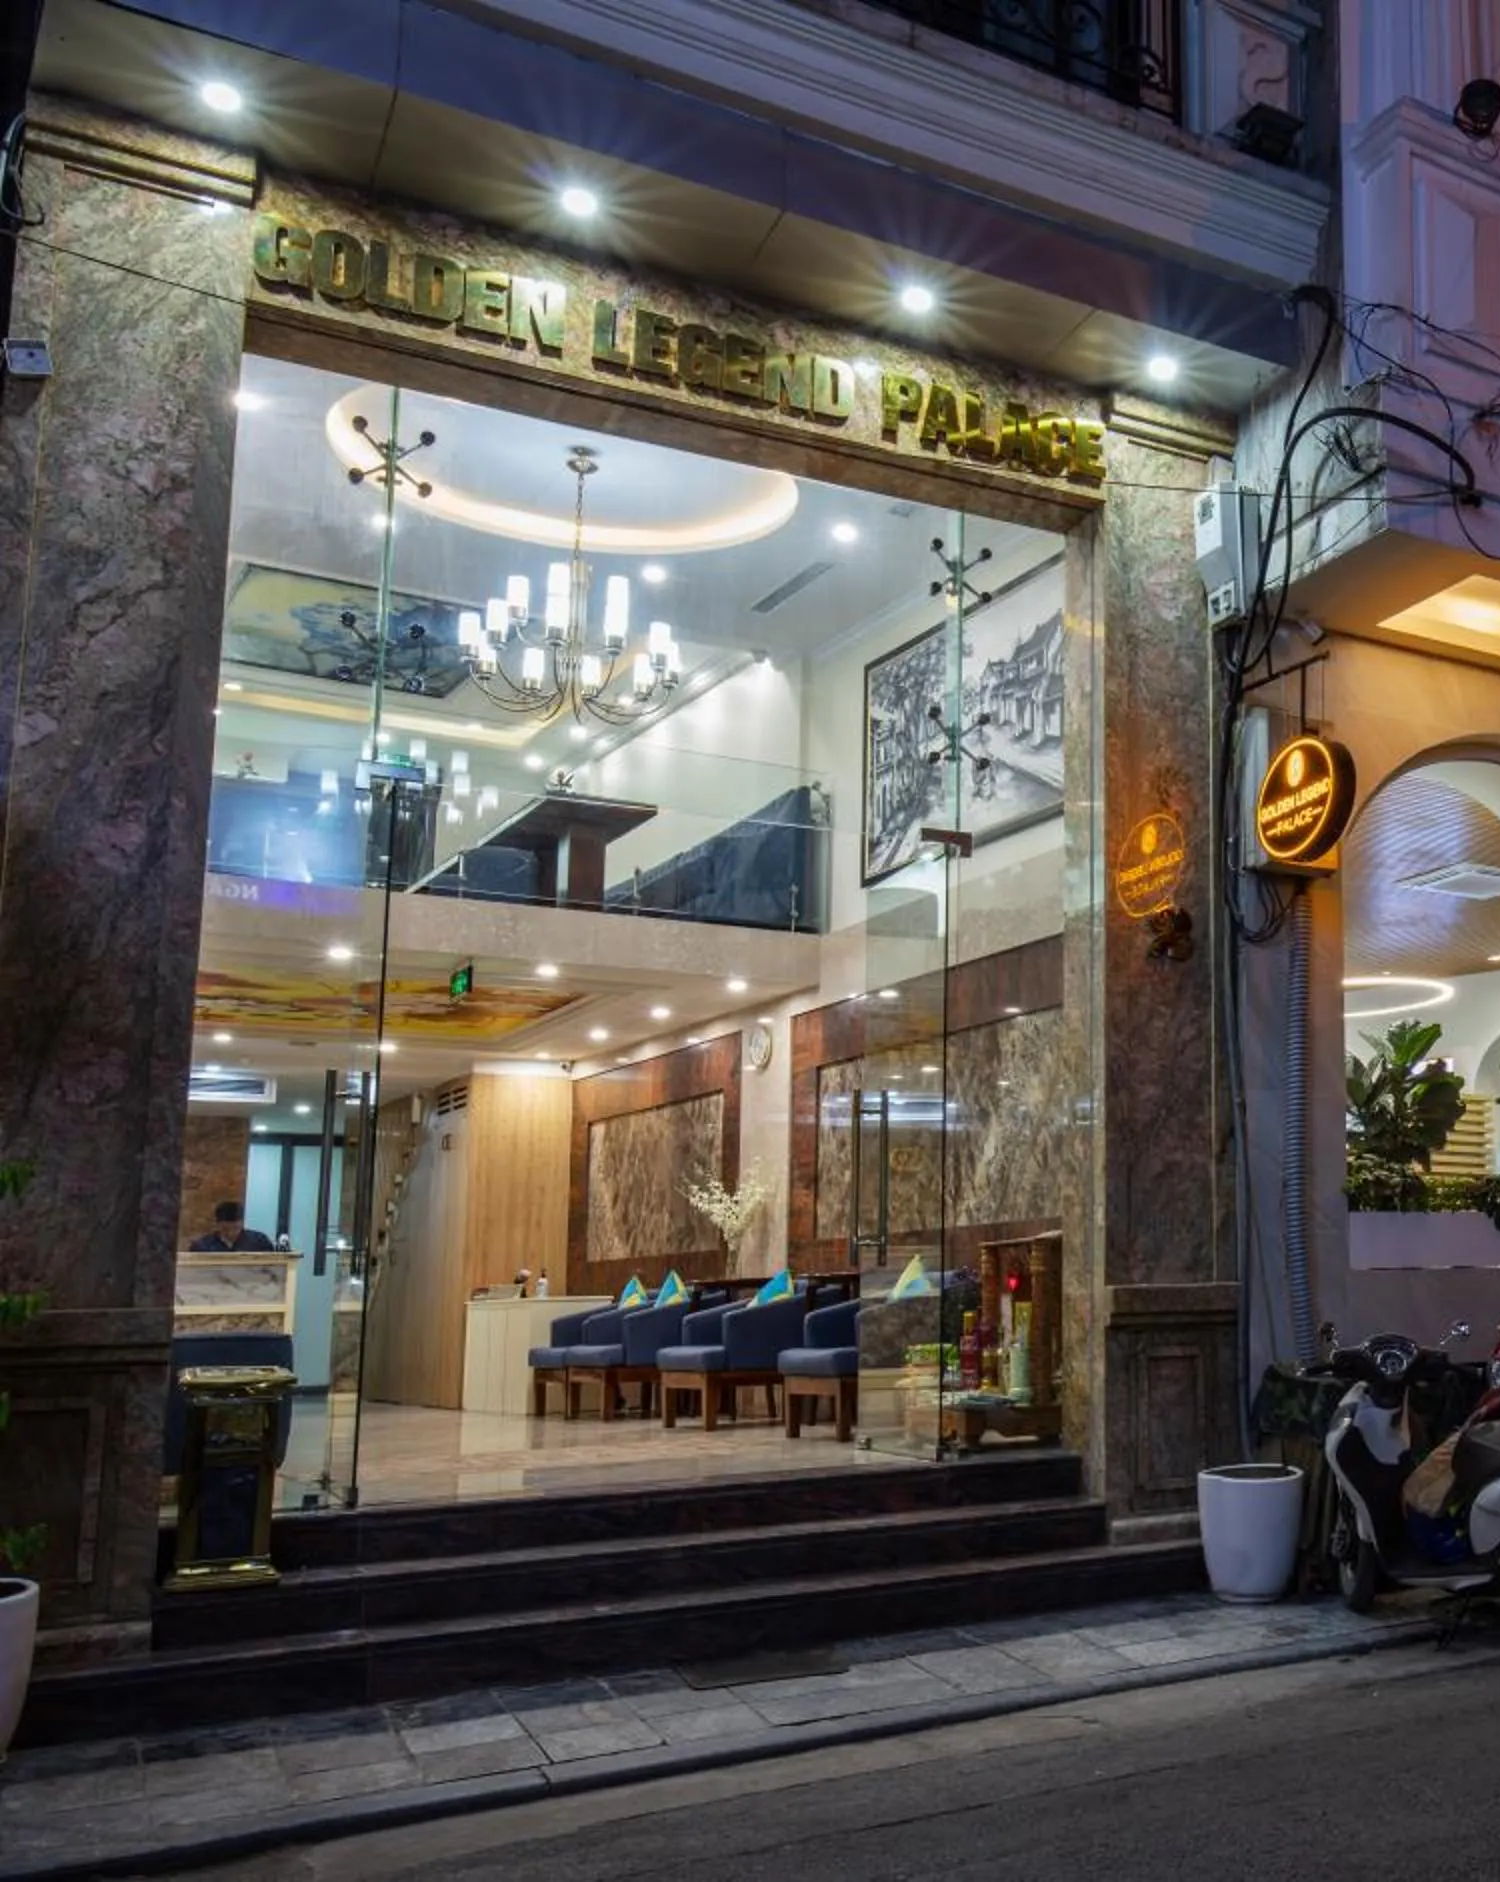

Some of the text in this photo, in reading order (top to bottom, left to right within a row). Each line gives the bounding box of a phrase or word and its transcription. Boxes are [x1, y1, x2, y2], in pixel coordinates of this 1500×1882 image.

[253, 212, 1107, 484] GOLDEN LEGEND PALACE
